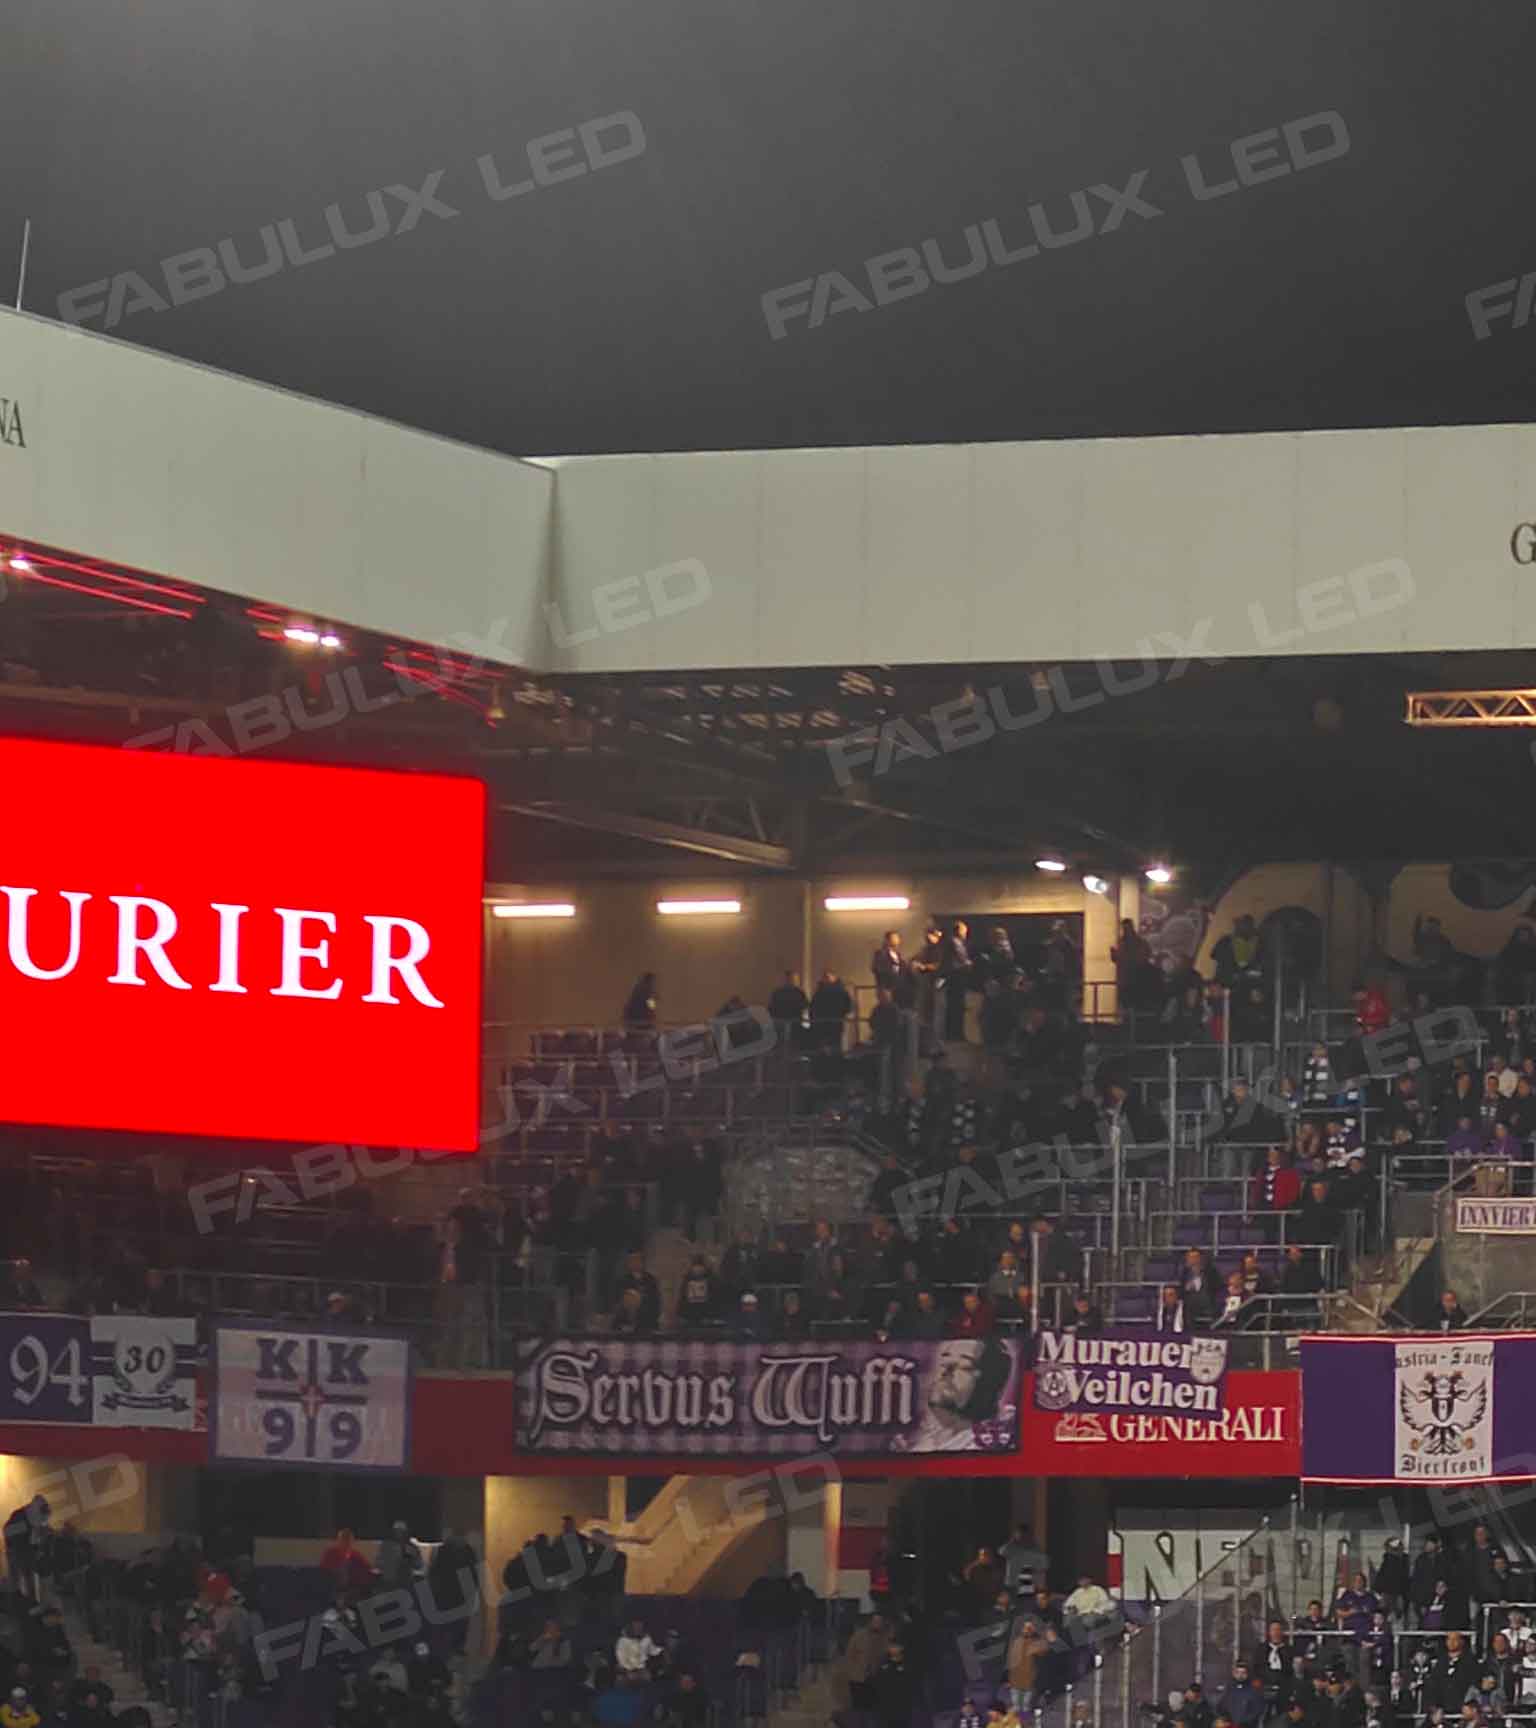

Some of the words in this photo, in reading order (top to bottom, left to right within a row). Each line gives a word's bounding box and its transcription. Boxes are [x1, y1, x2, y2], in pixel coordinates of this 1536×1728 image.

[0, 885, 444, 1009] URIER
[9, 1334, 90, 1407] 94
[123, 1345, 166, 1374] 30
[528, 1345, 735, 1445] Servus
[751, 1352, 917, 1442] Wuffi
[1066, 1368, 1220, 1411] Veilchen
